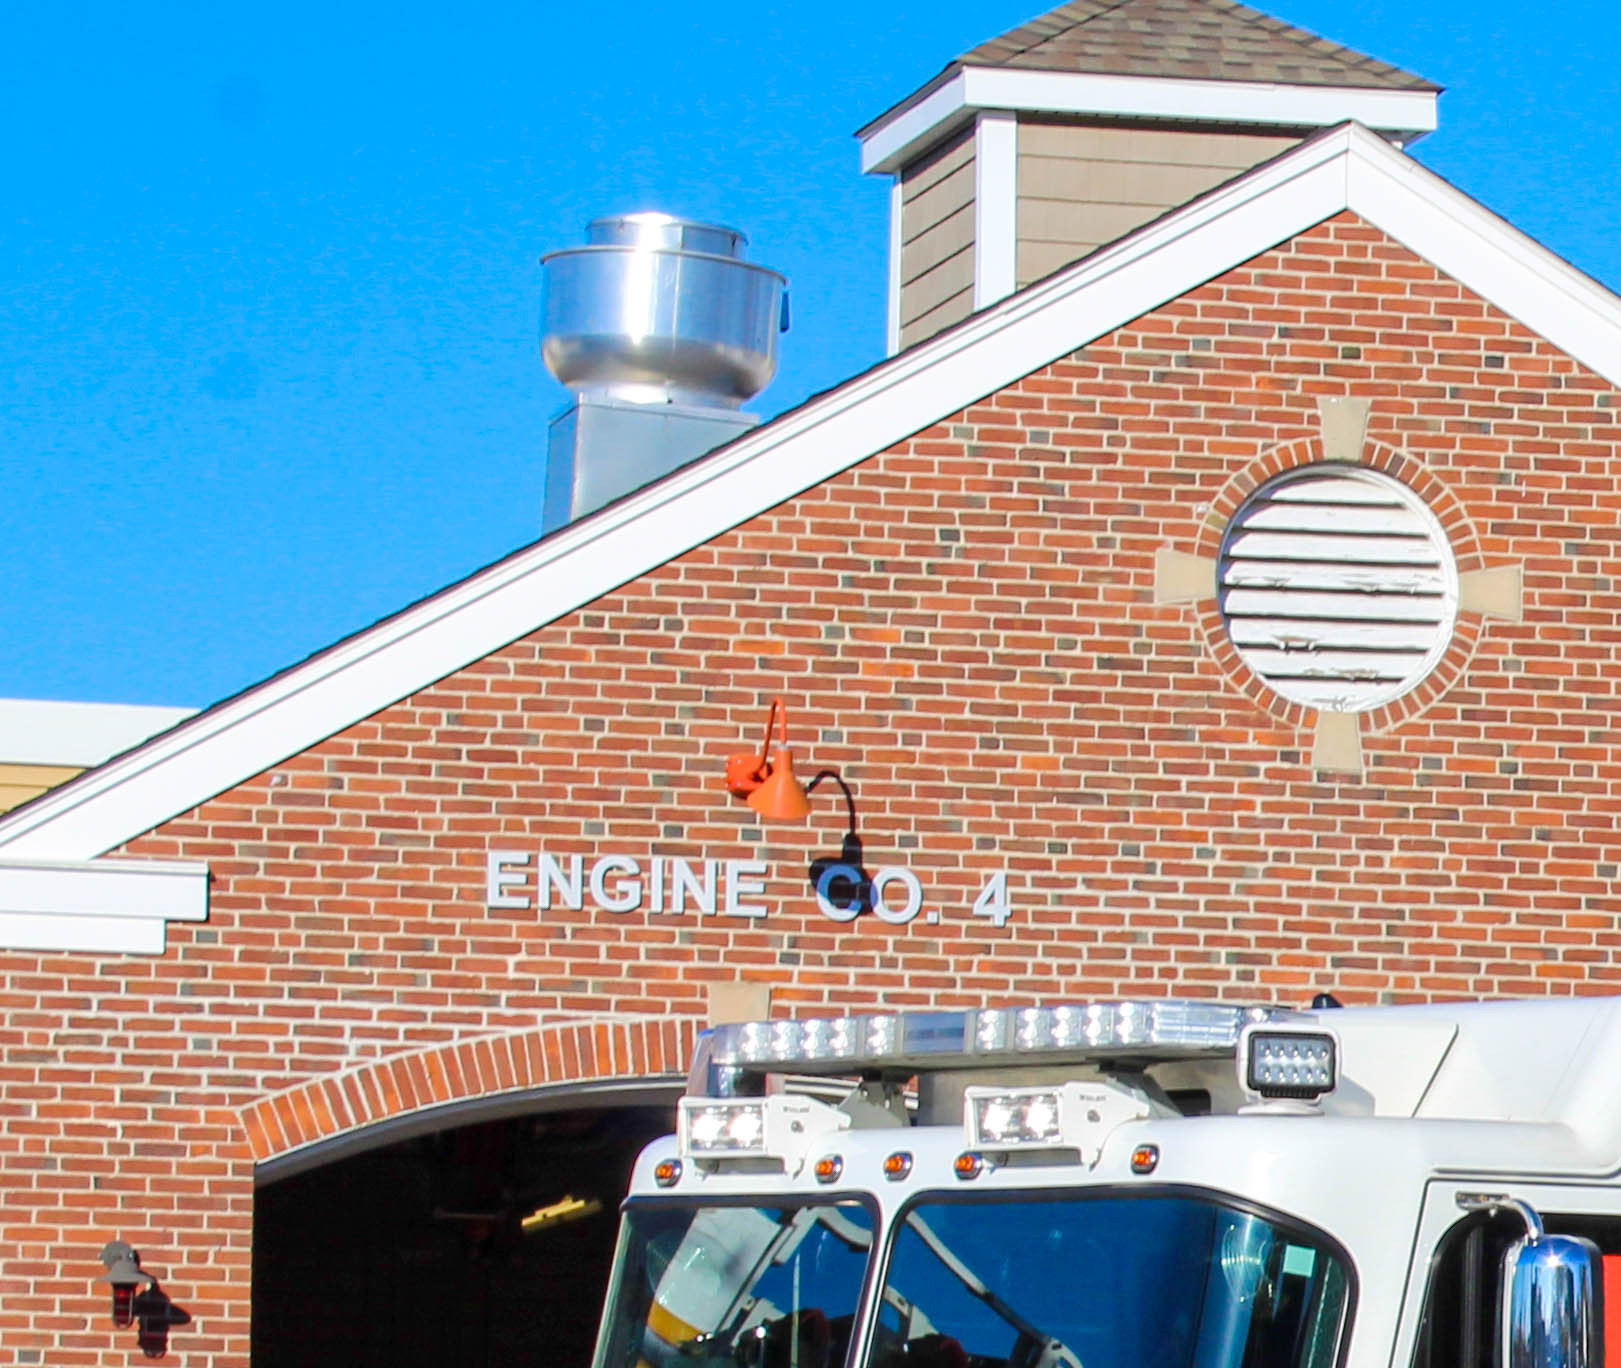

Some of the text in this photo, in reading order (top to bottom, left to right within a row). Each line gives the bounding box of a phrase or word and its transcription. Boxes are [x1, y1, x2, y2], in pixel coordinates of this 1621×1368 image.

[486, 851, 1012, 928] ENGINE CO. 4
